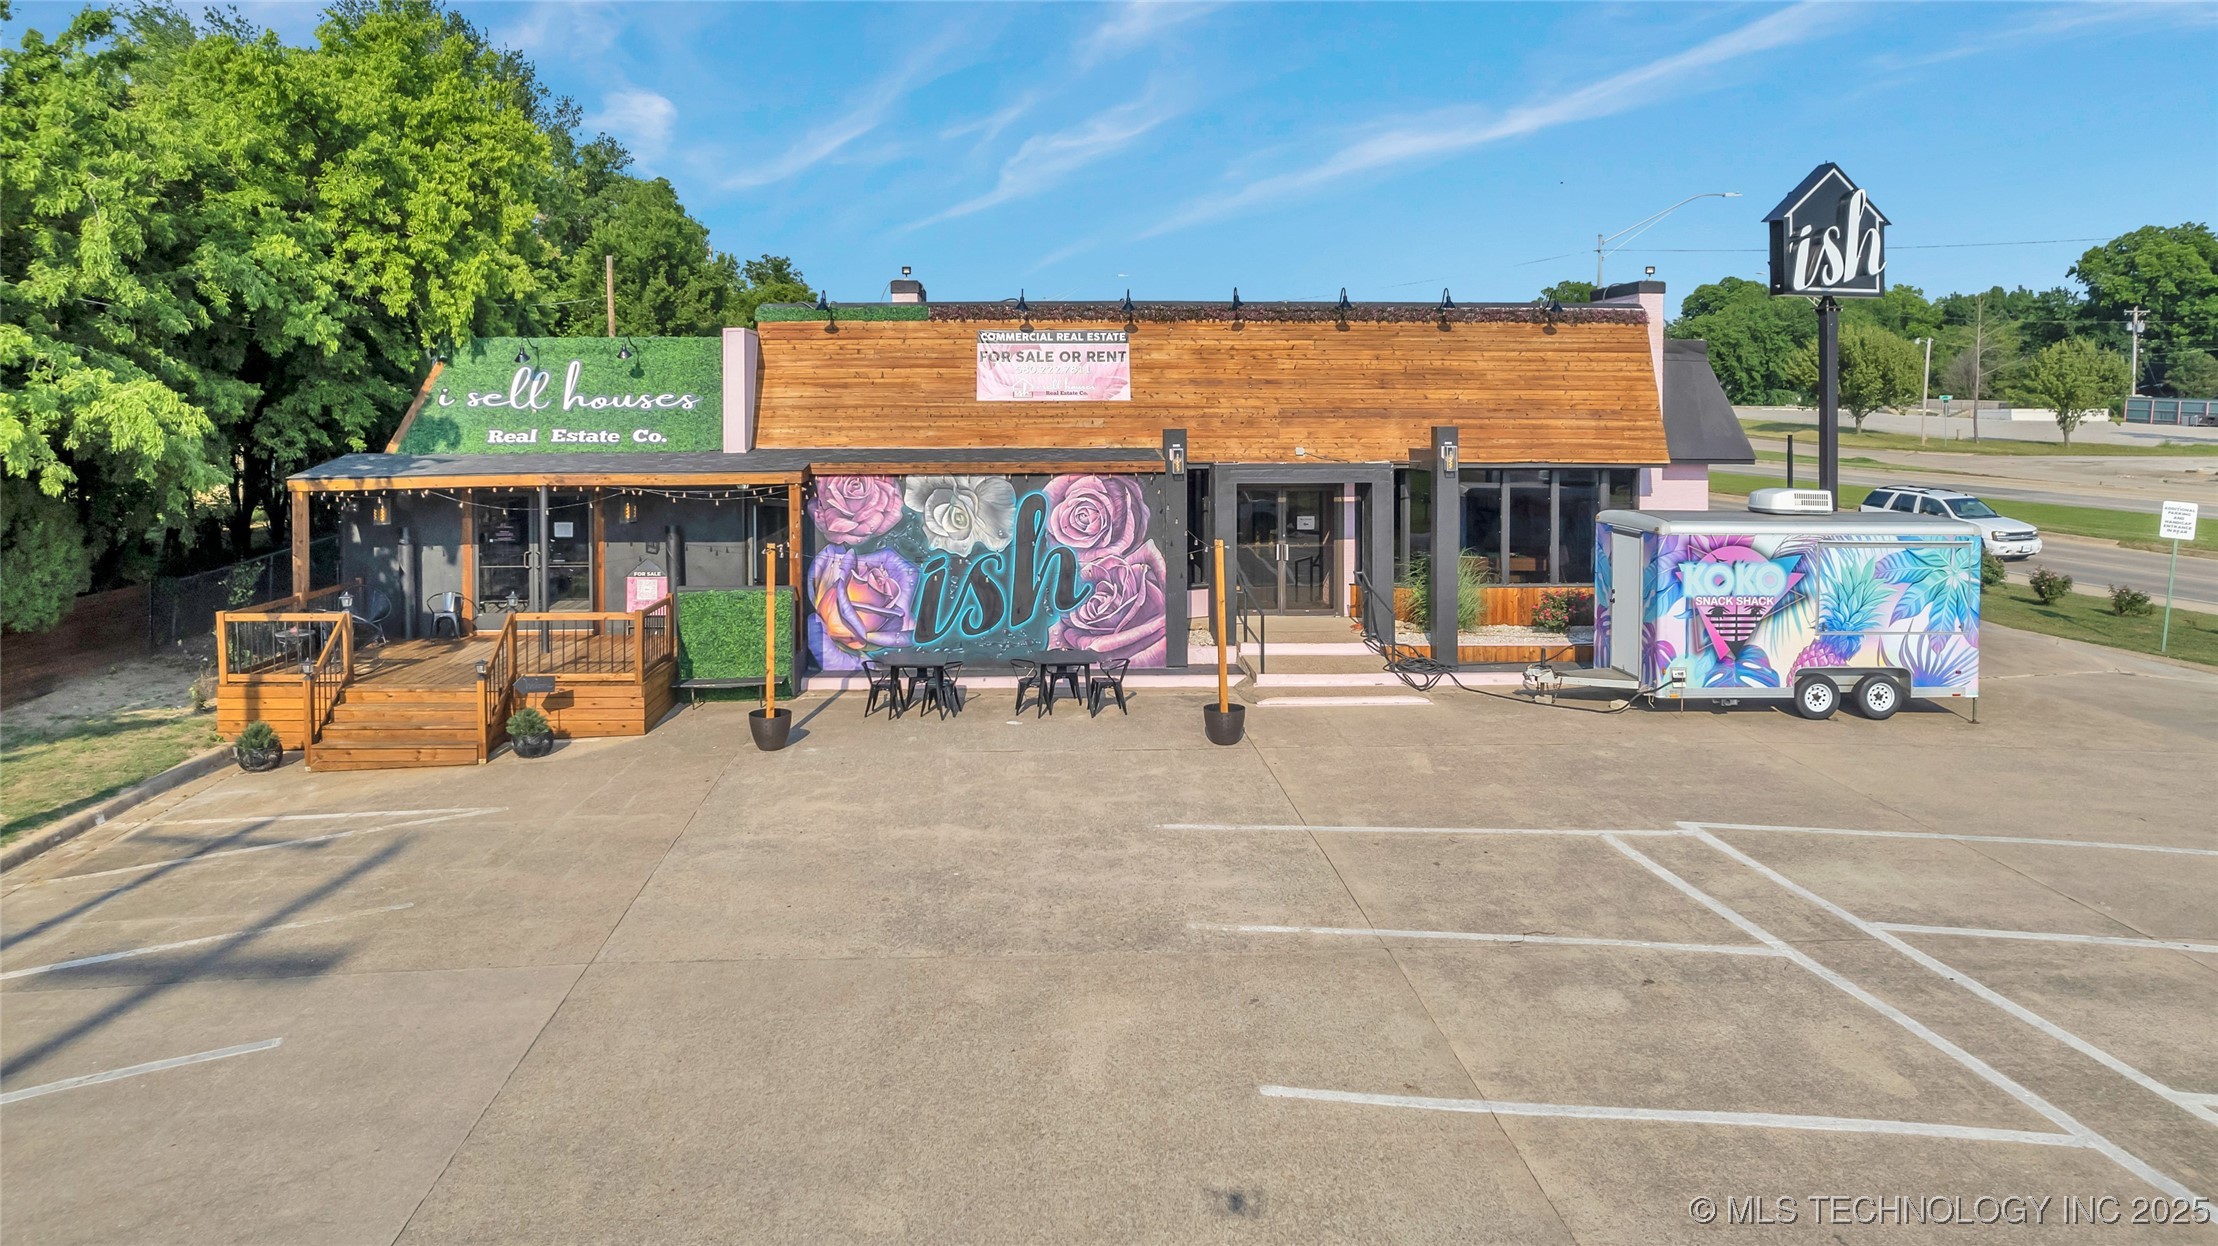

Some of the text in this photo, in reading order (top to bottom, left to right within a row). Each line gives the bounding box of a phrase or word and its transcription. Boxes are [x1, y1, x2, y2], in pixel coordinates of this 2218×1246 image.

[1789, 188, 1887, 291] ish
[980, 332, 1127, 342] COMMERCIAL REAL ESTATE
[979, 351, 1127, 363] FOR SALE OR RENT
[438, 359, 701, 412] i sell houses
[487, 428, 668, 444] Real Estate Co.
[913, 490, 1093, 645] ish
[1684, 562, 1787, 597] KOKO
[1695, 596, 1774, 606] SNACK SHACK
